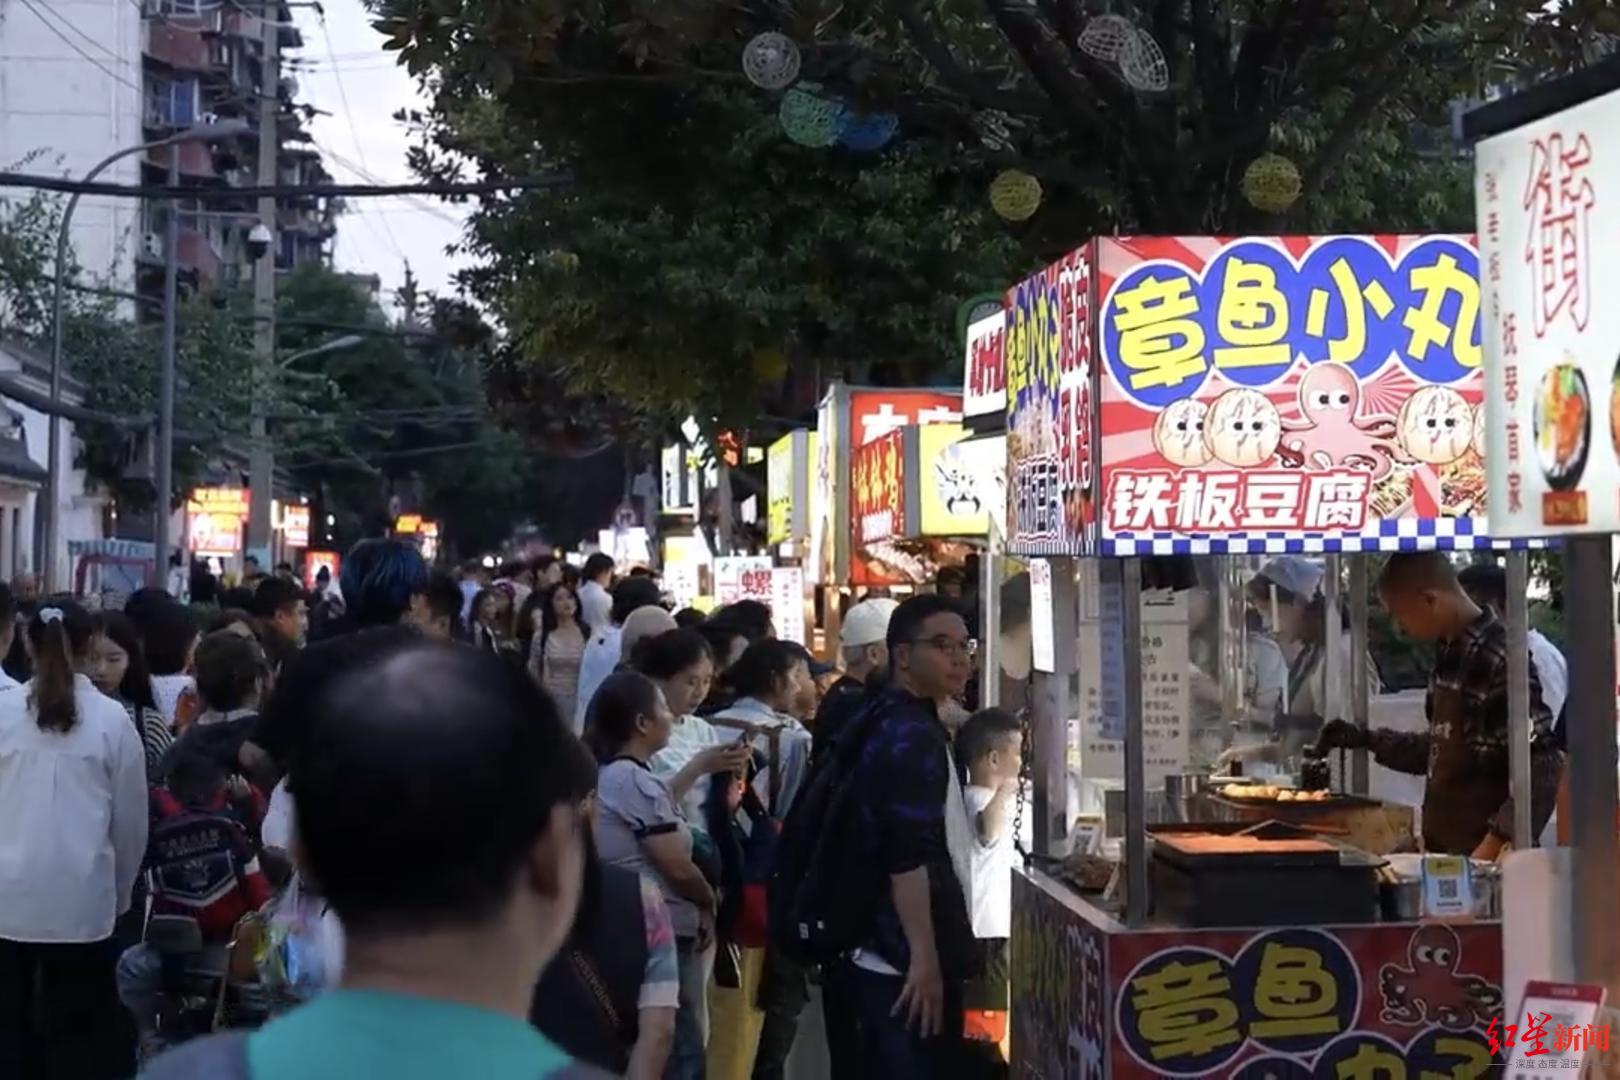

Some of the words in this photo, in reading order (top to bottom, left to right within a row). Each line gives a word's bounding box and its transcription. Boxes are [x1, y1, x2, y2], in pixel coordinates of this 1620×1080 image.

[1113, 255, 1482, 391] 章鱼小丸
[1108, 471, 1368, 531] 铁板豆腐
[741, 569, 774, 602] 螺
[1133, 942, 1341, 1062] 章鱼
